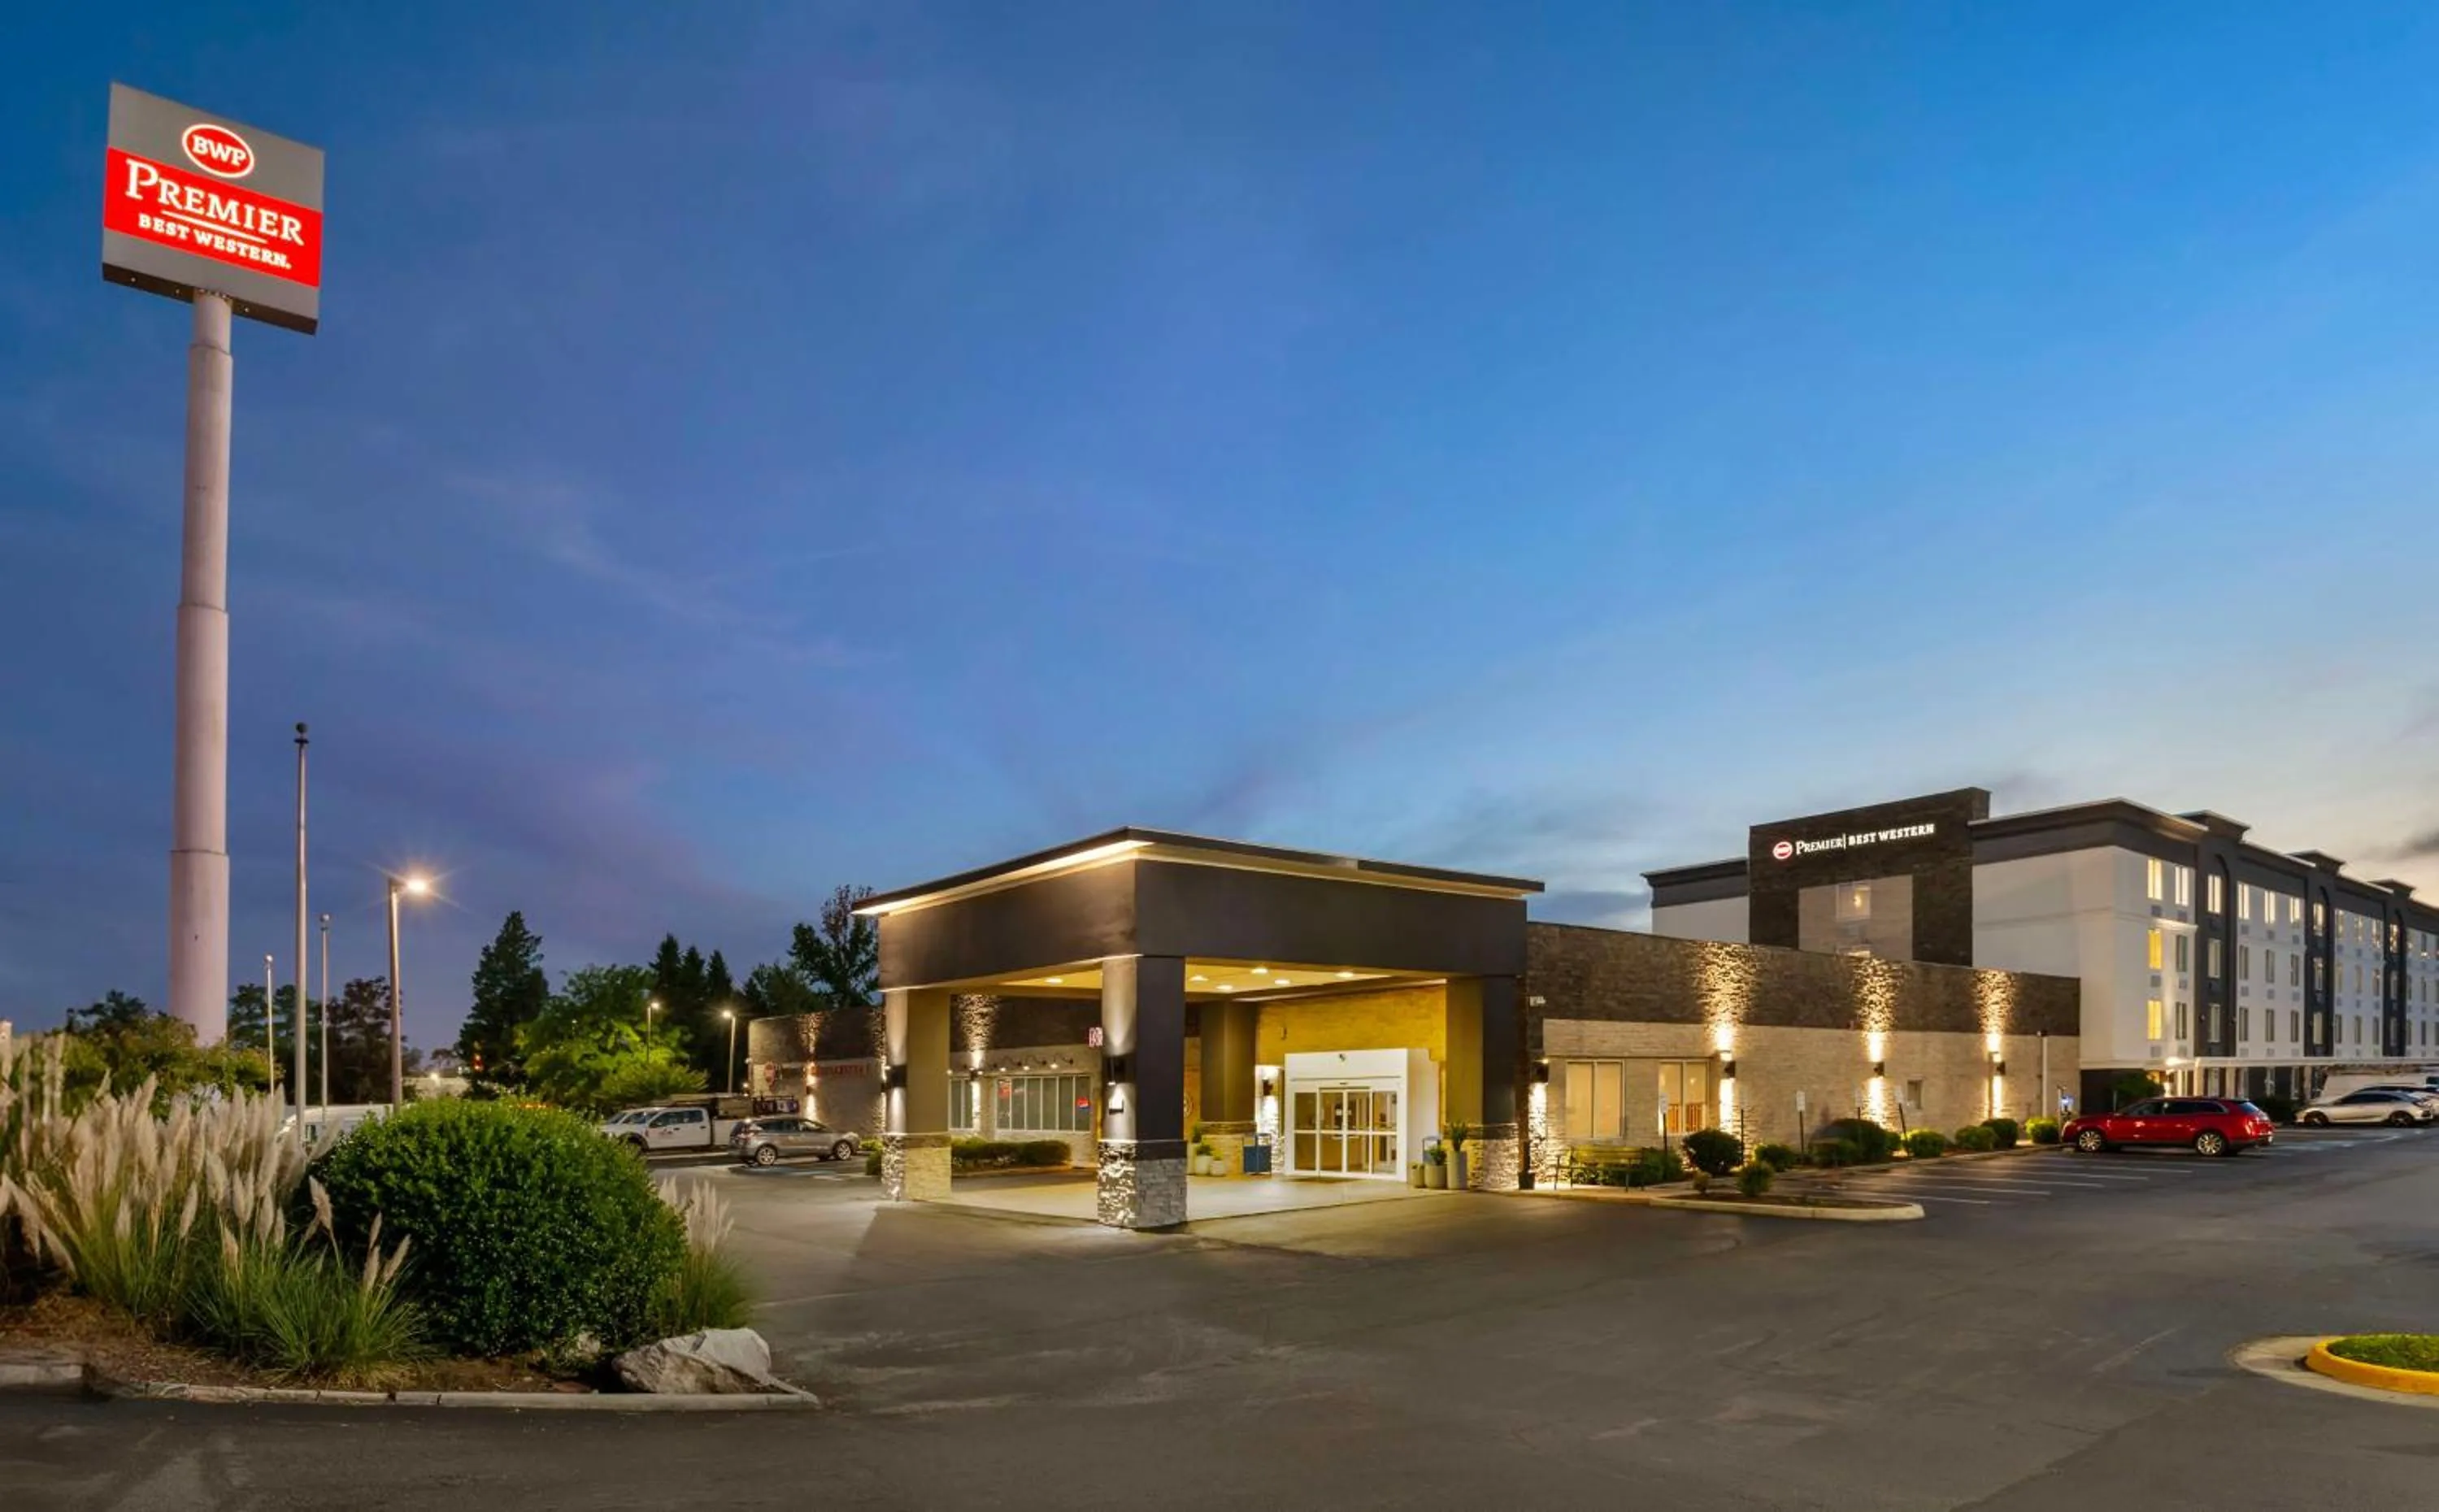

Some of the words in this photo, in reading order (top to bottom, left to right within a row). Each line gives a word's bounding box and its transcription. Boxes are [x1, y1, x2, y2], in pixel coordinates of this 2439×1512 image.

[192, 133, 246, 167] BWP
[125, 158, 305, 245] PREMIER
[138, 213, 189, 240] BEST
[1796, 837, 1843, 855] PREMIER
[1848, 832, 1876, 847] BEST
[1878, 823, 1935, 842] WESTERN
